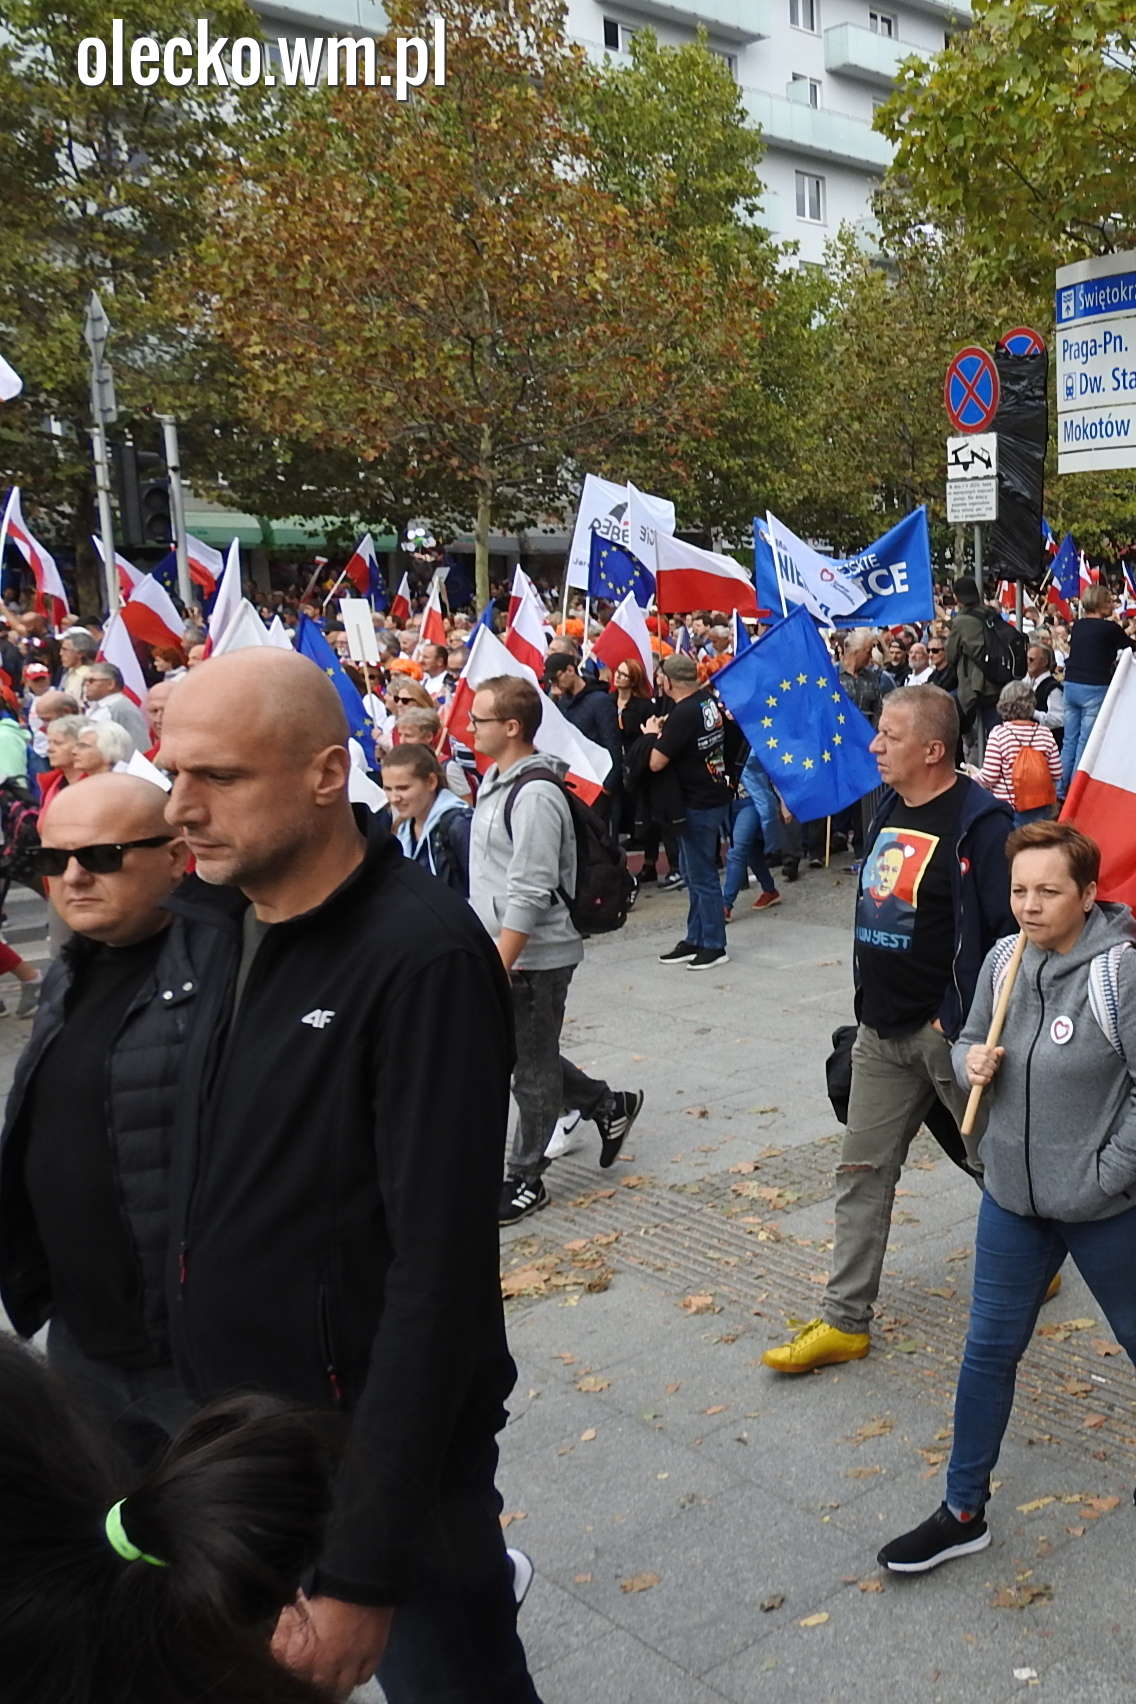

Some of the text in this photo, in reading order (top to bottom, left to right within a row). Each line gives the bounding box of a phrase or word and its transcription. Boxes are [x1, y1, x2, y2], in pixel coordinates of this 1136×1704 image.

[1062, 331, 1129, 365] Praga-Pn.
[1079, 373, 1106, 395] Dw.
[1063, 412, 1131, 443] Mokotów
[301, 1008, 336, 1029] 4F
